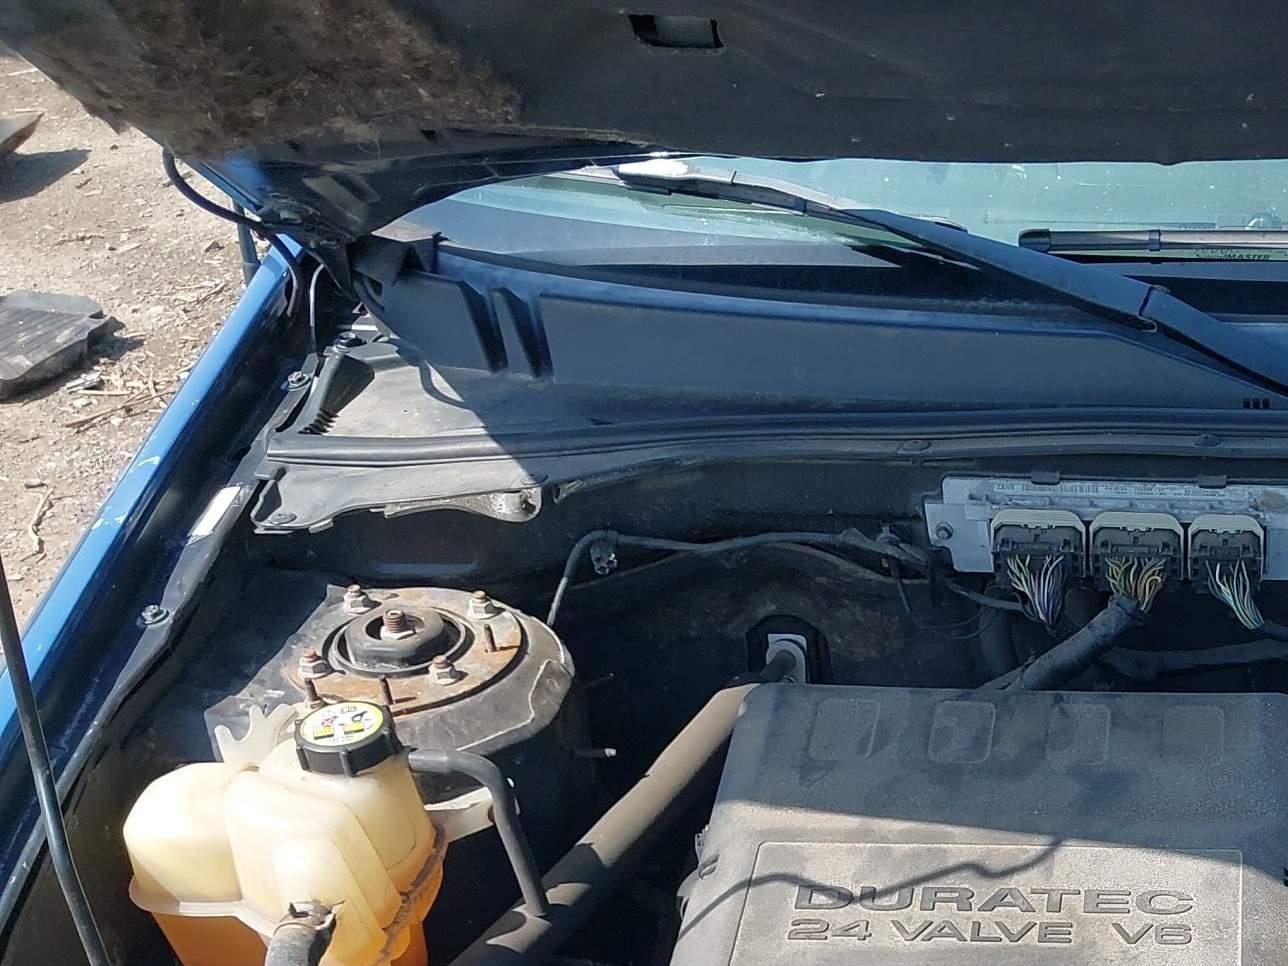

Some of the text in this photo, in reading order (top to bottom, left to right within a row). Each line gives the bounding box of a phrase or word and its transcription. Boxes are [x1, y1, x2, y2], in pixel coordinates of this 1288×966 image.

[794, 885, 1194, 915] DURATEC
[787, 918, 1193, 946] 24 VALVE V6
